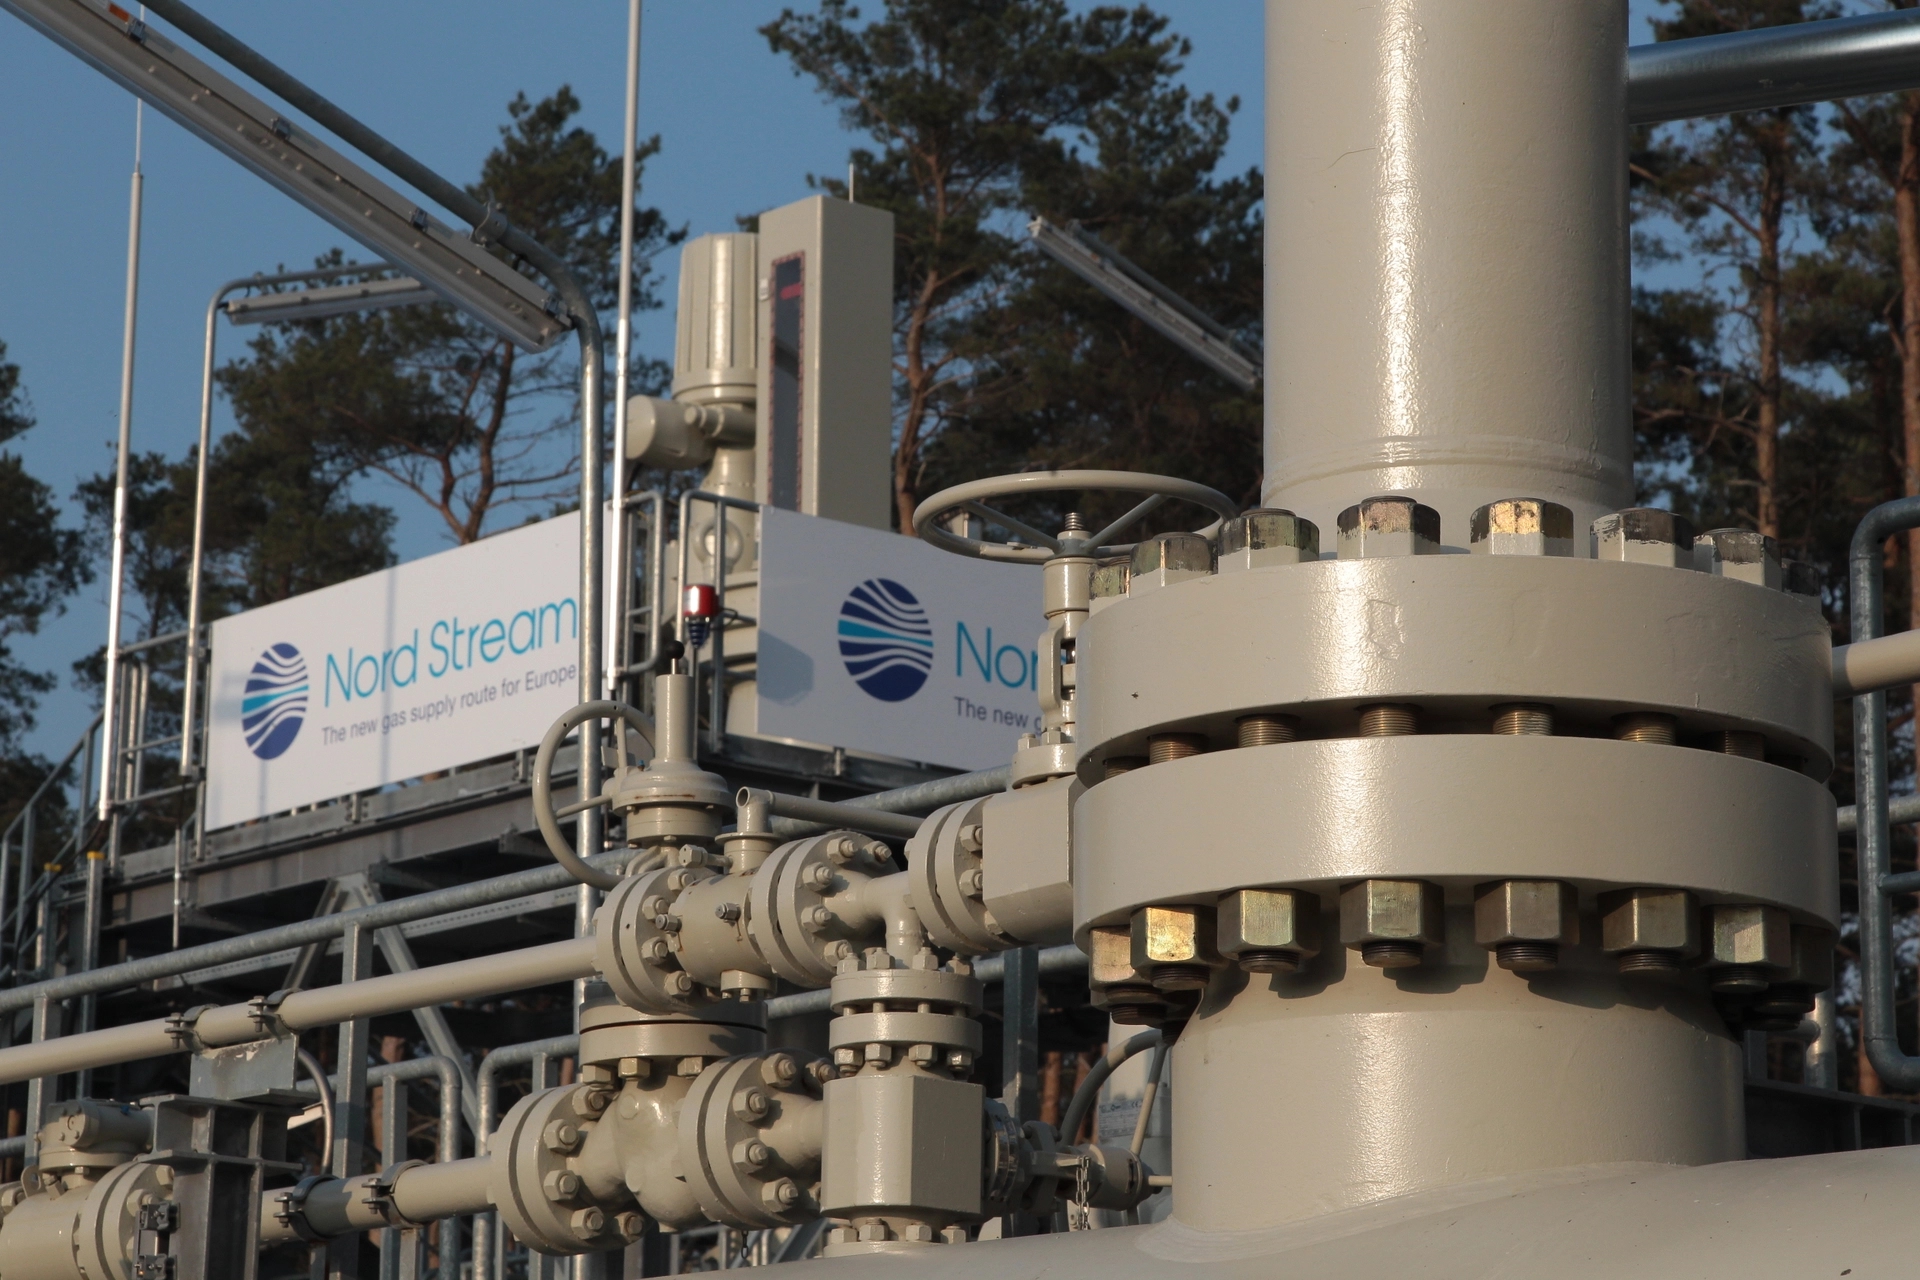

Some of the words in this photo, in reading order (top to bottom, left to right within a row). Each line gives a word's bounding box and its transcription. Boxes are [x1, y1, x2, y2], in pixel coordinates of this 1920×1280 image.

[325, 628, 419, 708] Nord
[428, 598, 577, 678] Stream
[956, 620, 1038, 692] Nor
[322, 726, 346, 746] The
[350, 718, 377, 739] new
[381, 708, 407, 735] gas
[410, 694, 457, 723] supply
[460, 684, 497, 709] route
[501, 677, 521, 698] for
[525, 664, 577, 692] Europe
[954, 696, 987, 721] The
[992, 708, 1029, 729] new
